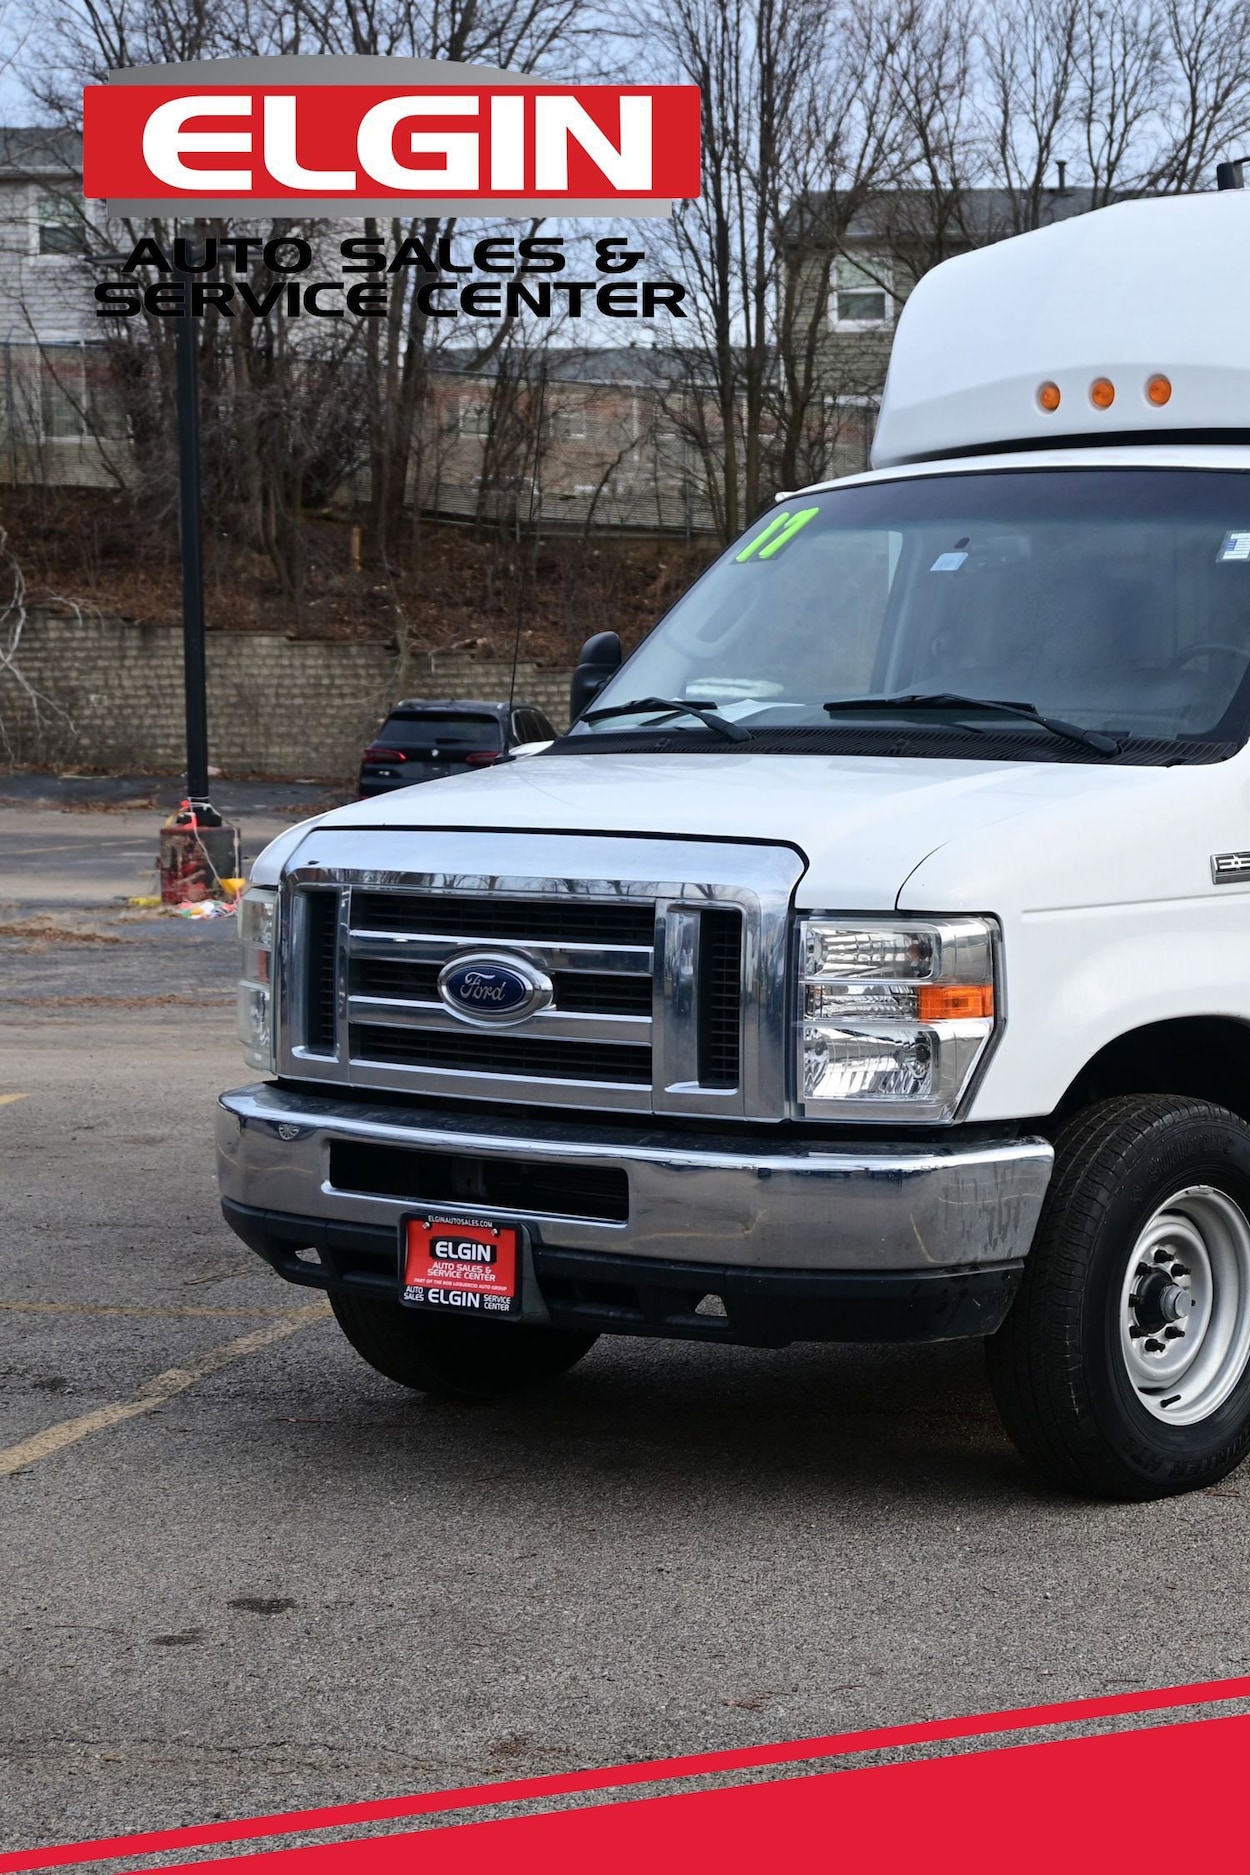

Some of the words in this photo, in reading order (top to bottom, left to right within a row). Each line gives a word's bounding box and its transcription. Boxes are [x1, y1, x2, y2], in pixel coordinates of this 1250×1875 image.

[735, 506, 820, 563] 17
[460, 972, 506, 1001] Ford
[428, 1215, 493, 1228] ELGINAUTOSALES.COM
[435, 1241, 491, 1262] ELGIN
[432, 1262, 454, 1271] AUTO
[456, 1264, 482, 1273] SALES
[427, 1269, 462, 1278] SERVICE
[464, 1273, 496, 1282] CENTER
[405, 1286, 423, 1294] AUTO
[403, 1293, 424, 1302] SALES
[428, 1288, 480, 1308] ELGIN
[483, 1294, 511, 1305] SERVICE
[484, 1302, 510, 1312] CENTER
